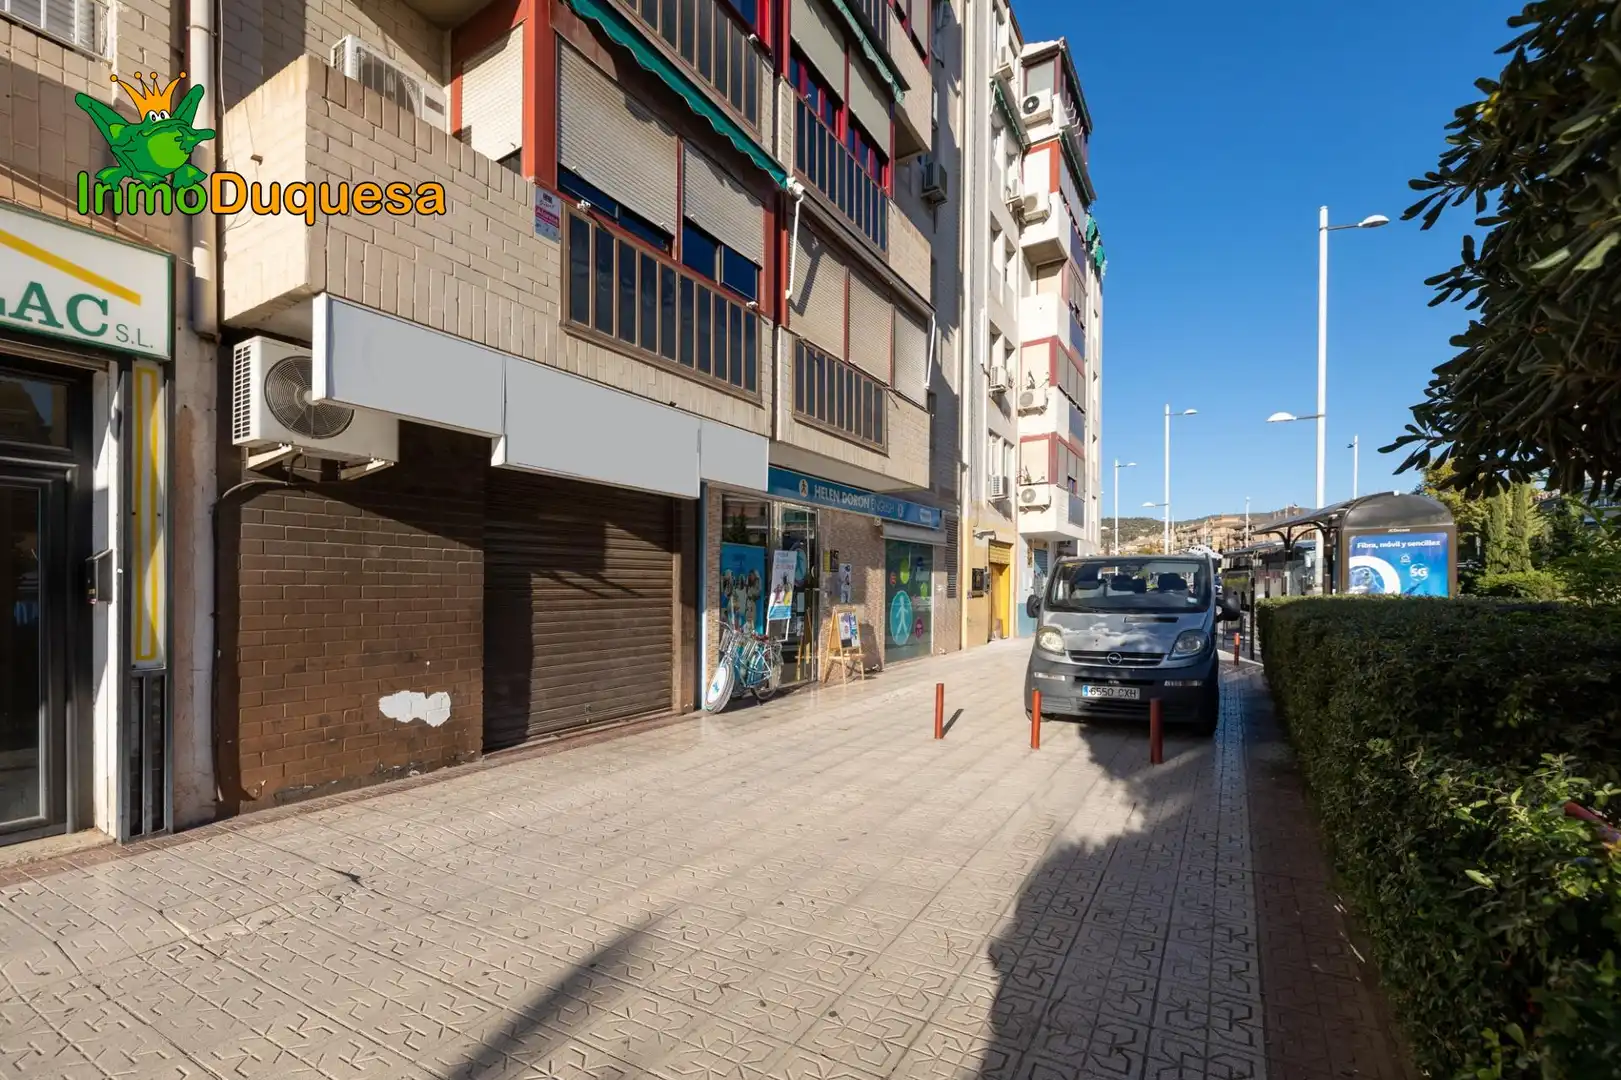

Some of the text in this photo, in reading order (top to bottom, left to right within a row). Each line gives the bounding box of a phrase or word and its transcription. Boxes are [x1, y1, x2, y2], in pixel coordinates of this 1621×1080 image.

[115, 323, 154, 348] S.L.
[814, 484, 840, 502] HELEN
[841, 492, 871, 509] DORON
[1410, 567, 1428, 577] 5G
[1090, 687, 1114, 697] 6550
